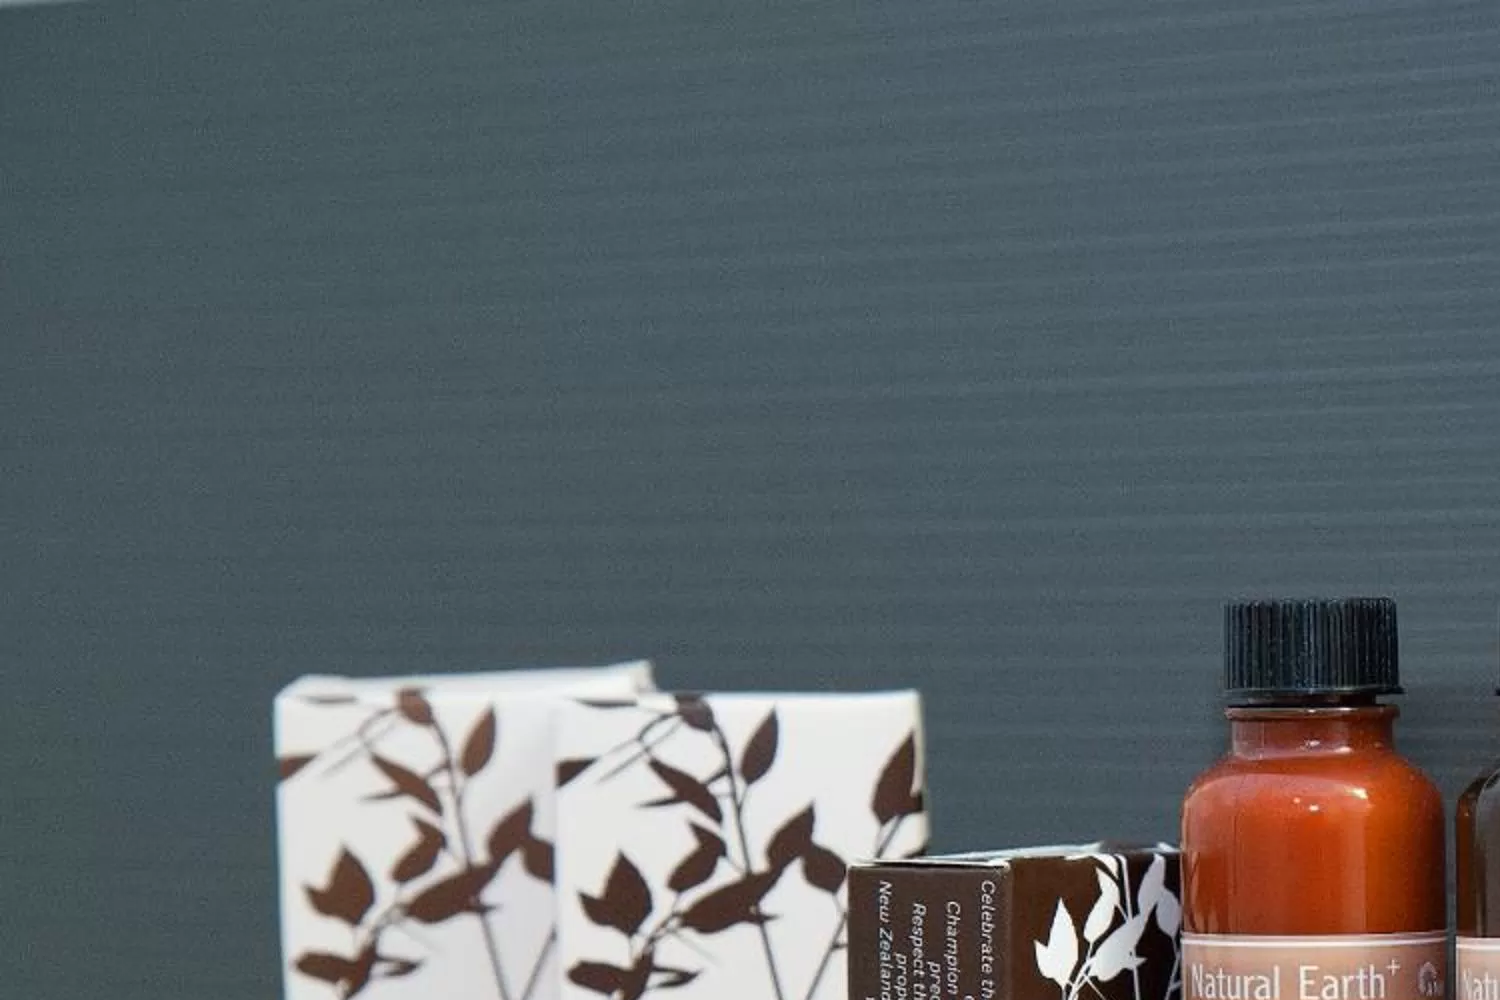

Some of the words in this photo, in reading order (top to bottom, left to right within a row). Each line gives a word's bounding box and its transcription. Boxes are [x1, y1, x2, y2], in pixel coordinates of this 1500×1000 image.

[879, 881, 892, 923] New
[981, 880, 996, 974] Celebrate
[909, 903, 926, 977] Respect
[944, 901, 961, 995] Champion
[1191, 963, 1280, 1000] Natural
